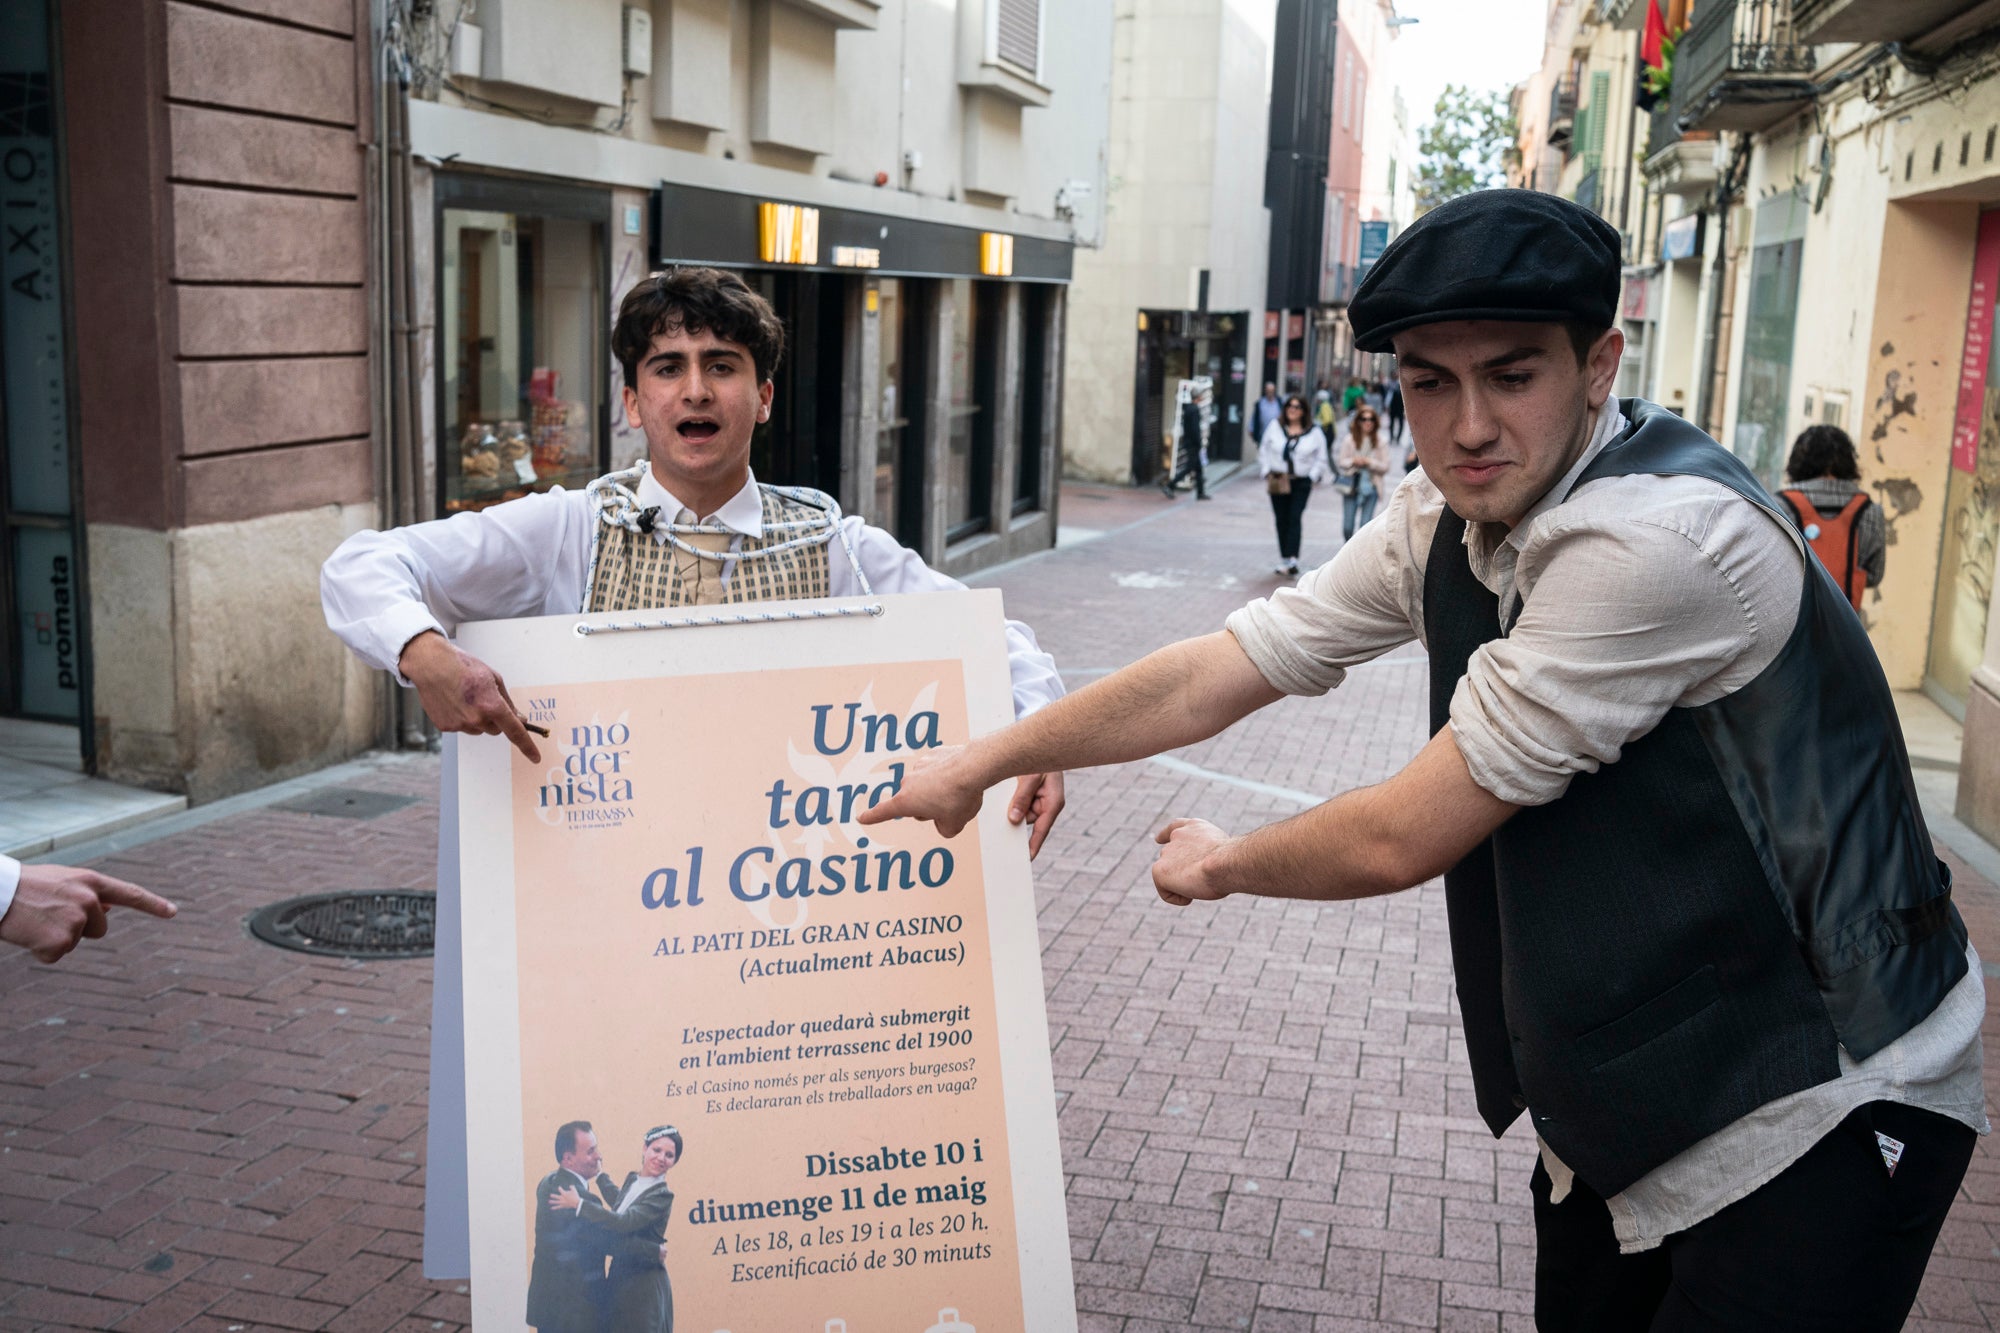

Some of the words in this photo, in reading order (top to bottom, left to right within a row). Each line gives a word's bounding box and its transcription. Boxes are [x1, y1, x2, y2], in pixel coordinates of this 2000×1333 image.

[51, 555, 77, 690] promata
[528, 698, 556, 710] XXII
[528, 711, 556, 722] FIRA
[571, 723, 630, 747] mo
[810, 702, 943, 756] Una
[564, 747, 631, 777] der
[539, 772, 634, 807] nista
[765, 762, 905, 829] tard
[567, 807, 634, 822] TERRASSA
[641, 846, 704, 910] al
[729, 836, 955, 902] Casino
[653, 937, 684, 956] AL
[692, 932, 744, 953] PATI
[750, 928, 795, 949] DEL
[802, 921, 870, 944] GRAN
[876, 914, 963, 938] CASINO
[740, 951, 873, 984] (Actualment
[879, 941, 965, 967] Abacus)
[682, 1020, 796, 1046] L'espectador
[800, 1012, 875, 1039] quedarà
[880, 1004, 970, 1028] submergit
[679, 1056, 700, 1069] en
[707, 1046, 792, 1067] l'ambient
[797, 1040, 891, 1059] terrassenc
[896, 1032, 922, 1051] del
[928, 1029, 973, 1048] 1900
[666, 1080, 681, 1097] És
[686, 1081, 697, 1095] el
[702, 1079, 749, 1093] Casino
[754, 1073, 798, 1089] només
[803, 1074, 825, 1088] per
[829, 1068, 849, 1083] als
[854, 1067, 905, 1082] senyors
[909, 1057, 976, 1077] burgesos?
[706, 1100, 721, 1113] Es
[726, 1095, 802, 1111] declararan
[806, 1090, 824, 1104] els
[829, 1083, 913, 1103] treballadors
[916, 1084, 933, 1095] en
[937, 1077, 977, 1095] vaga?
[805, 1146, 927, 1178] Dissabte
[934, 1141, 965, 1166] 10
[973, 1138, 984, 1163] i
[688, 1195, 833, 1225] diumenge
[840, 1187, 866, 1211] 11
[873, 1182, 907, 1208] de
[914, 1175, 987, 1206] maig
[712, 1236, 728, 1255] A
[735, 1233, 760, 1253] les
[767, 1230, 793, 1252] 18,
[800, 1233, 812, 1247] a
[819, 1225, 844, 1245] les
[851, 1223, 872, 1243] 19
[878, 1221, 884, 1240] i
[890, 1224, 902, 1239] a
[909, 1217, 934, 1237] les
[940, 1214, 965, 1234] 20
[972, 1211, 988, 1231] h.
[731, 1251, 857, 1283] Escenificació
[864, 1249, 887, 1270] de
[892, 1247, 917, 1267] 30
[923, 1242, 991, 1264] minuts
